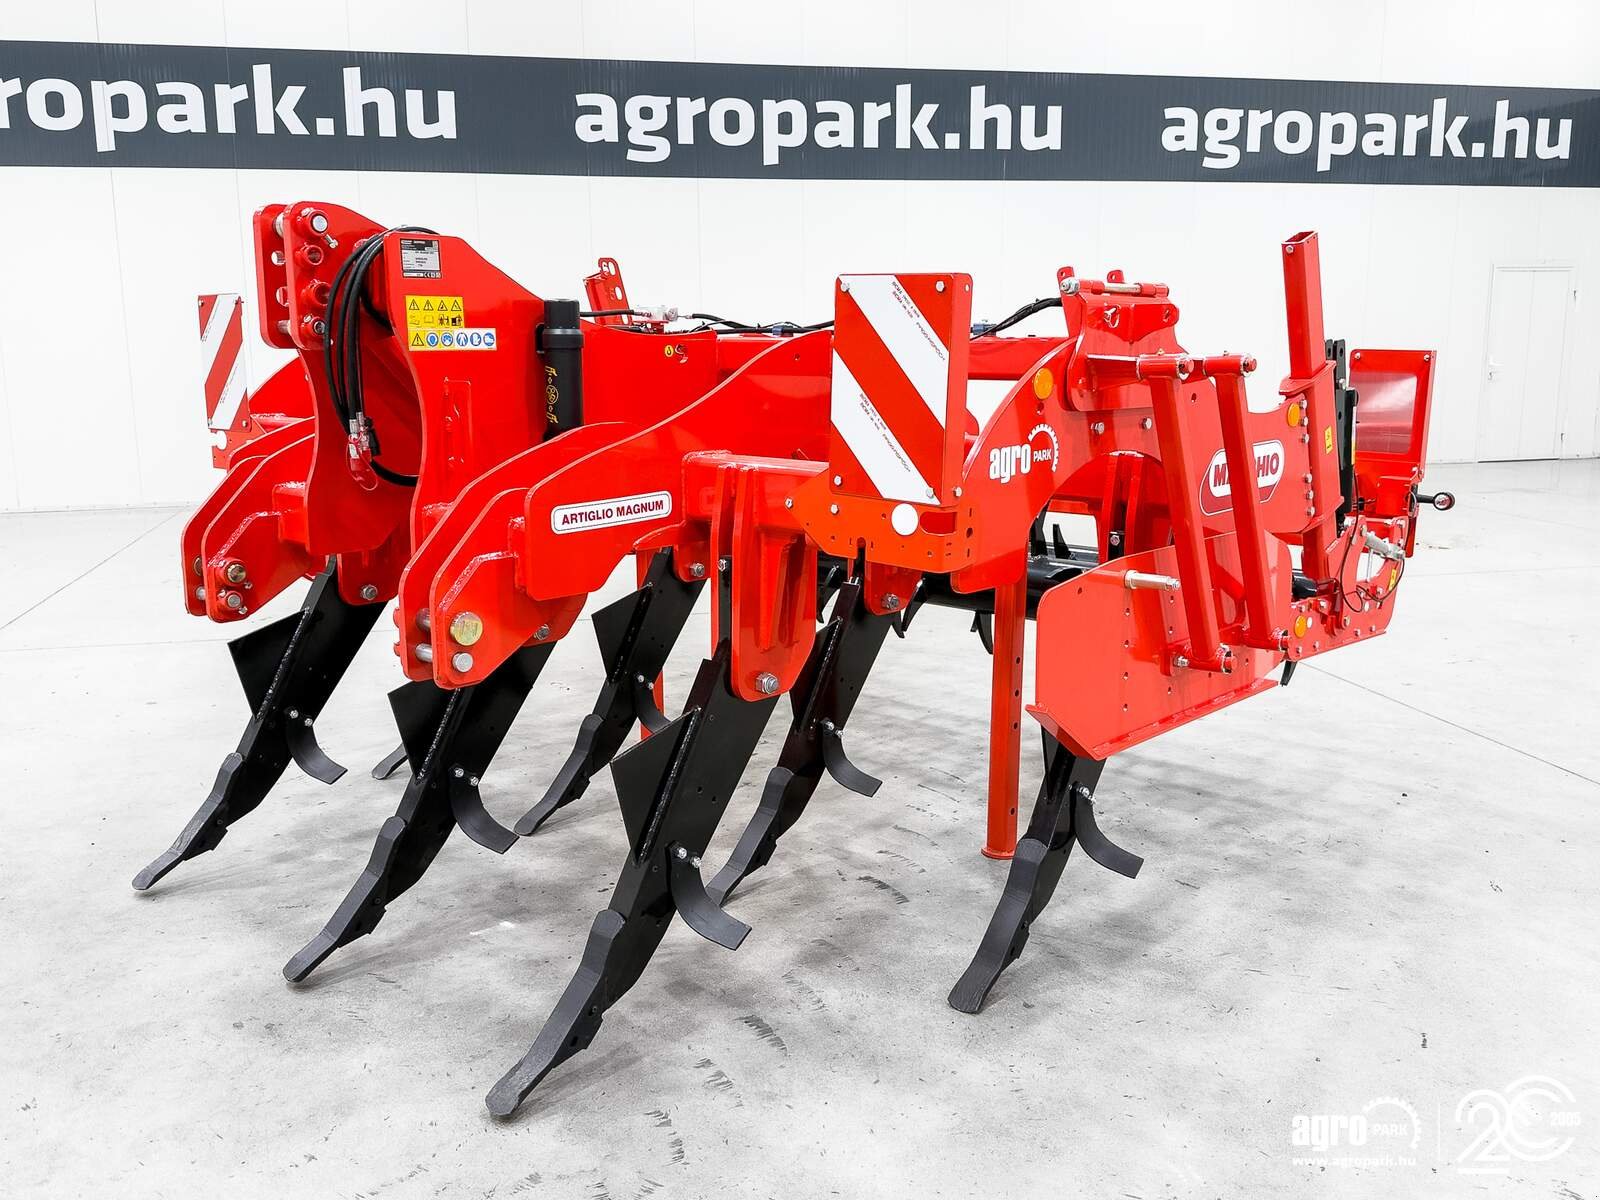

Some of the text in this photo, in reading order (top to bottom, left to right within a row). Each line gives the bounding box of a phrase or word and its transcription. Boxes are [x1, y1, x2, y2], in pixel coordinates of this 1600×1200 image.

[574, 83, 1063, 166] agropark.hu
[1161, 97, 1573, 172] agropark.hu
[989, 443, 1052, 484] agro PARK
[562, 500, 664, 525] ARTIGLIO MAGNUM
